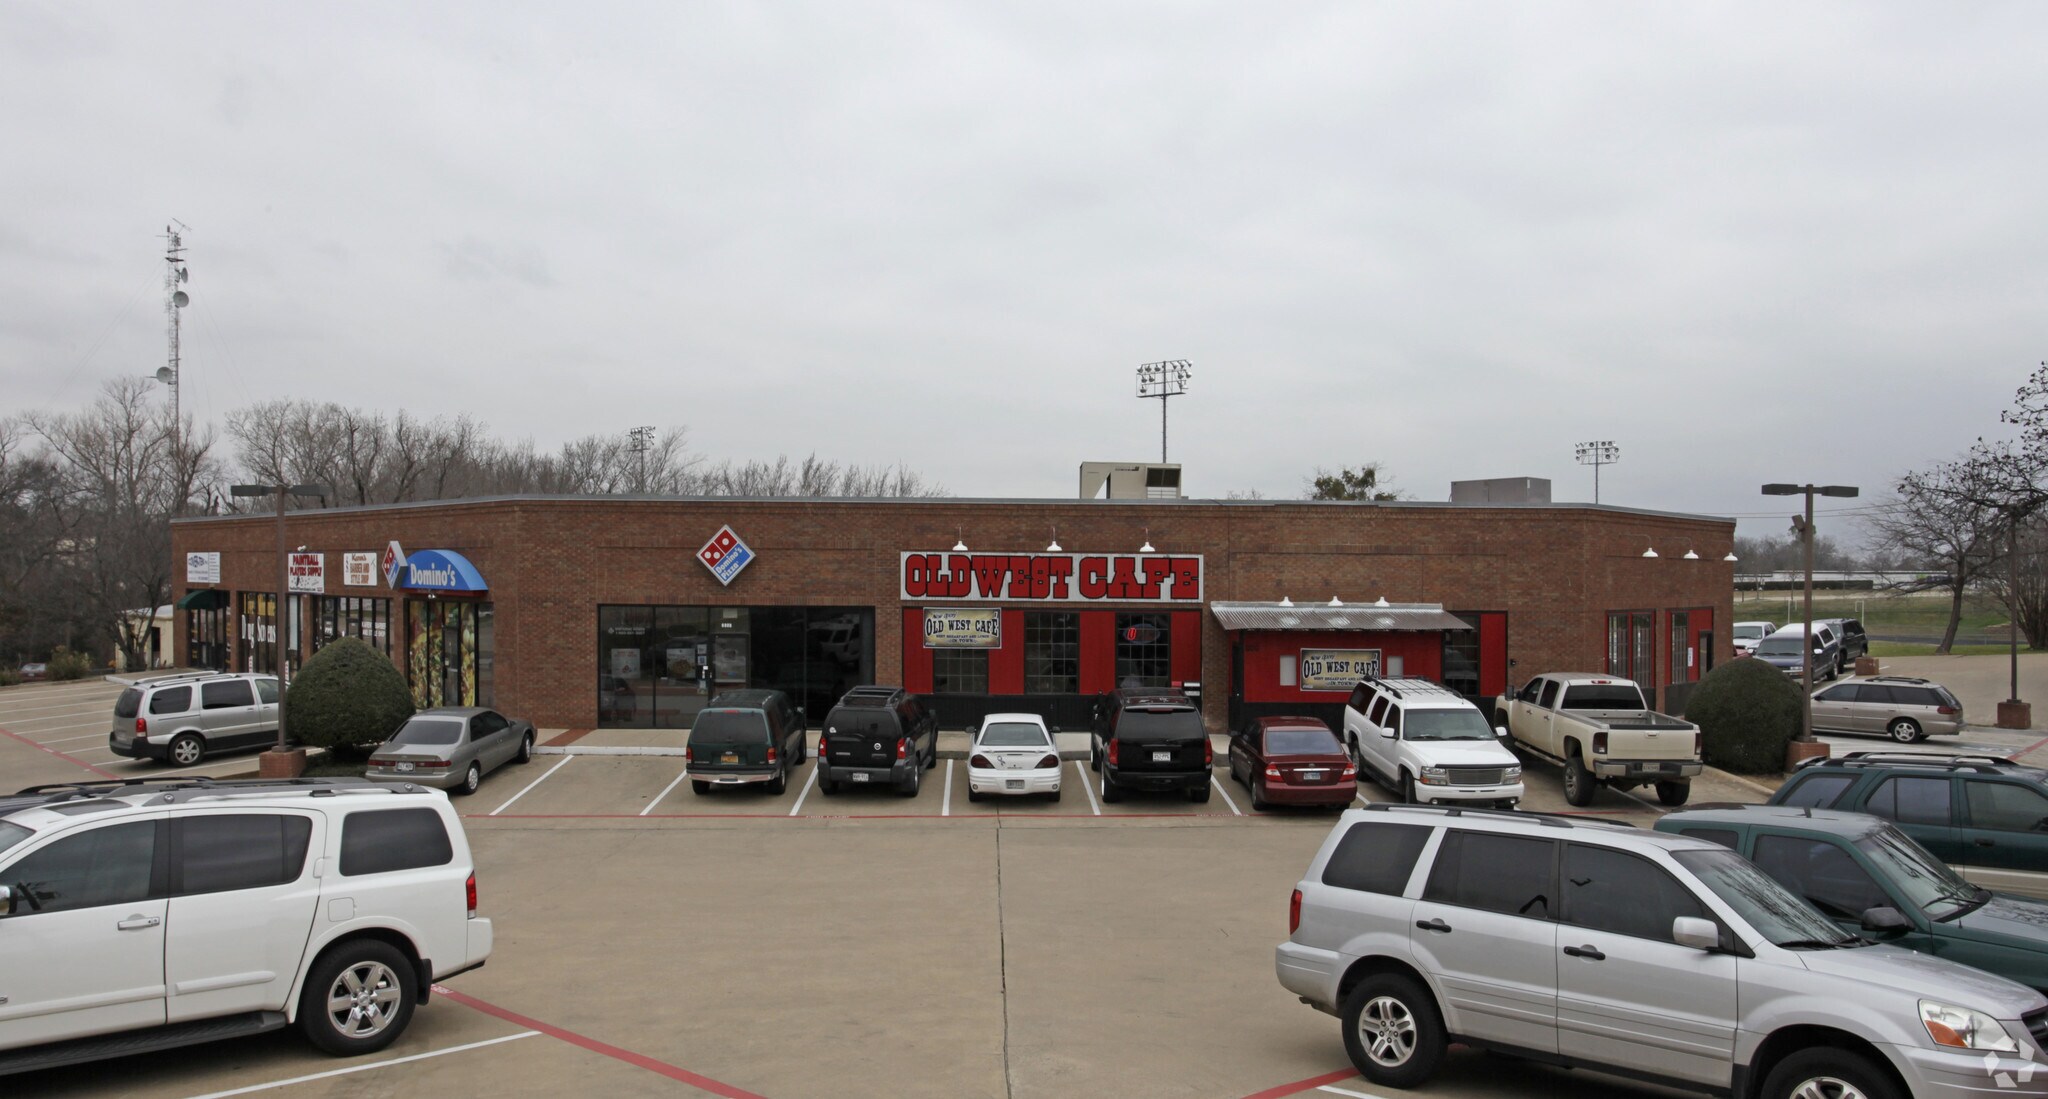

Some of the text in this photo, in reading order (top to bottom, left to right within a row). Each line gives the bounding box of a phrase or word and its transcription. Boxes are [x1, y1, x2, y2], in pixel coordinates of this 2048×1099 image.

[293, 555, 319, 565] PAINTBALL
[715, 547, 742, 574] Domino's
[308, 567, 322, 577] SUPPLY
[410, 562, 456, 587] Domino's
[720, 562, 739, 580] Pizza
[1079, 556, 1199, 599] CAFE
[926, 618, 999, 636] OLD WEST CAFE
[1303, 660, 1322, 678] OLD
[1326, 661, 1350, 673] WEST
